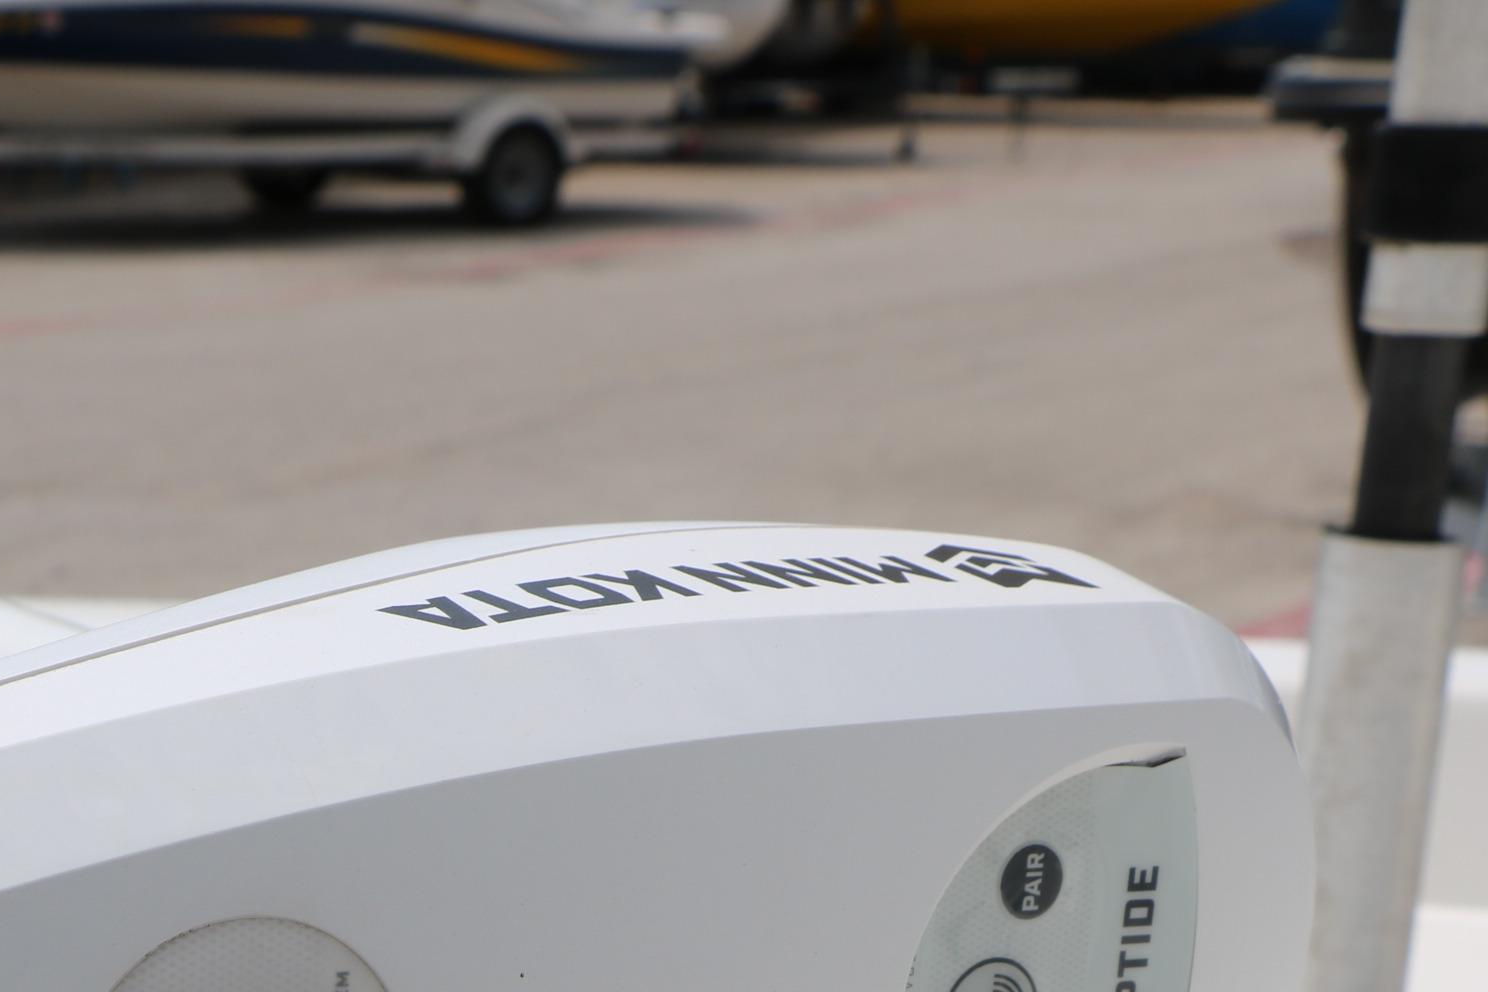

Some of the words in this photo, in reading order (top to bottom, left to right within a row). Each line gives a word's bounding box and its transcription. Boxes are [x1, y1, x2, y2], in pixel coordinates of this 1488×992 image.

[375, 568, 702, 631] KOTA
[672, 556, 958, 592] MINN
[1020, 851, 1045, 913] PAIR
